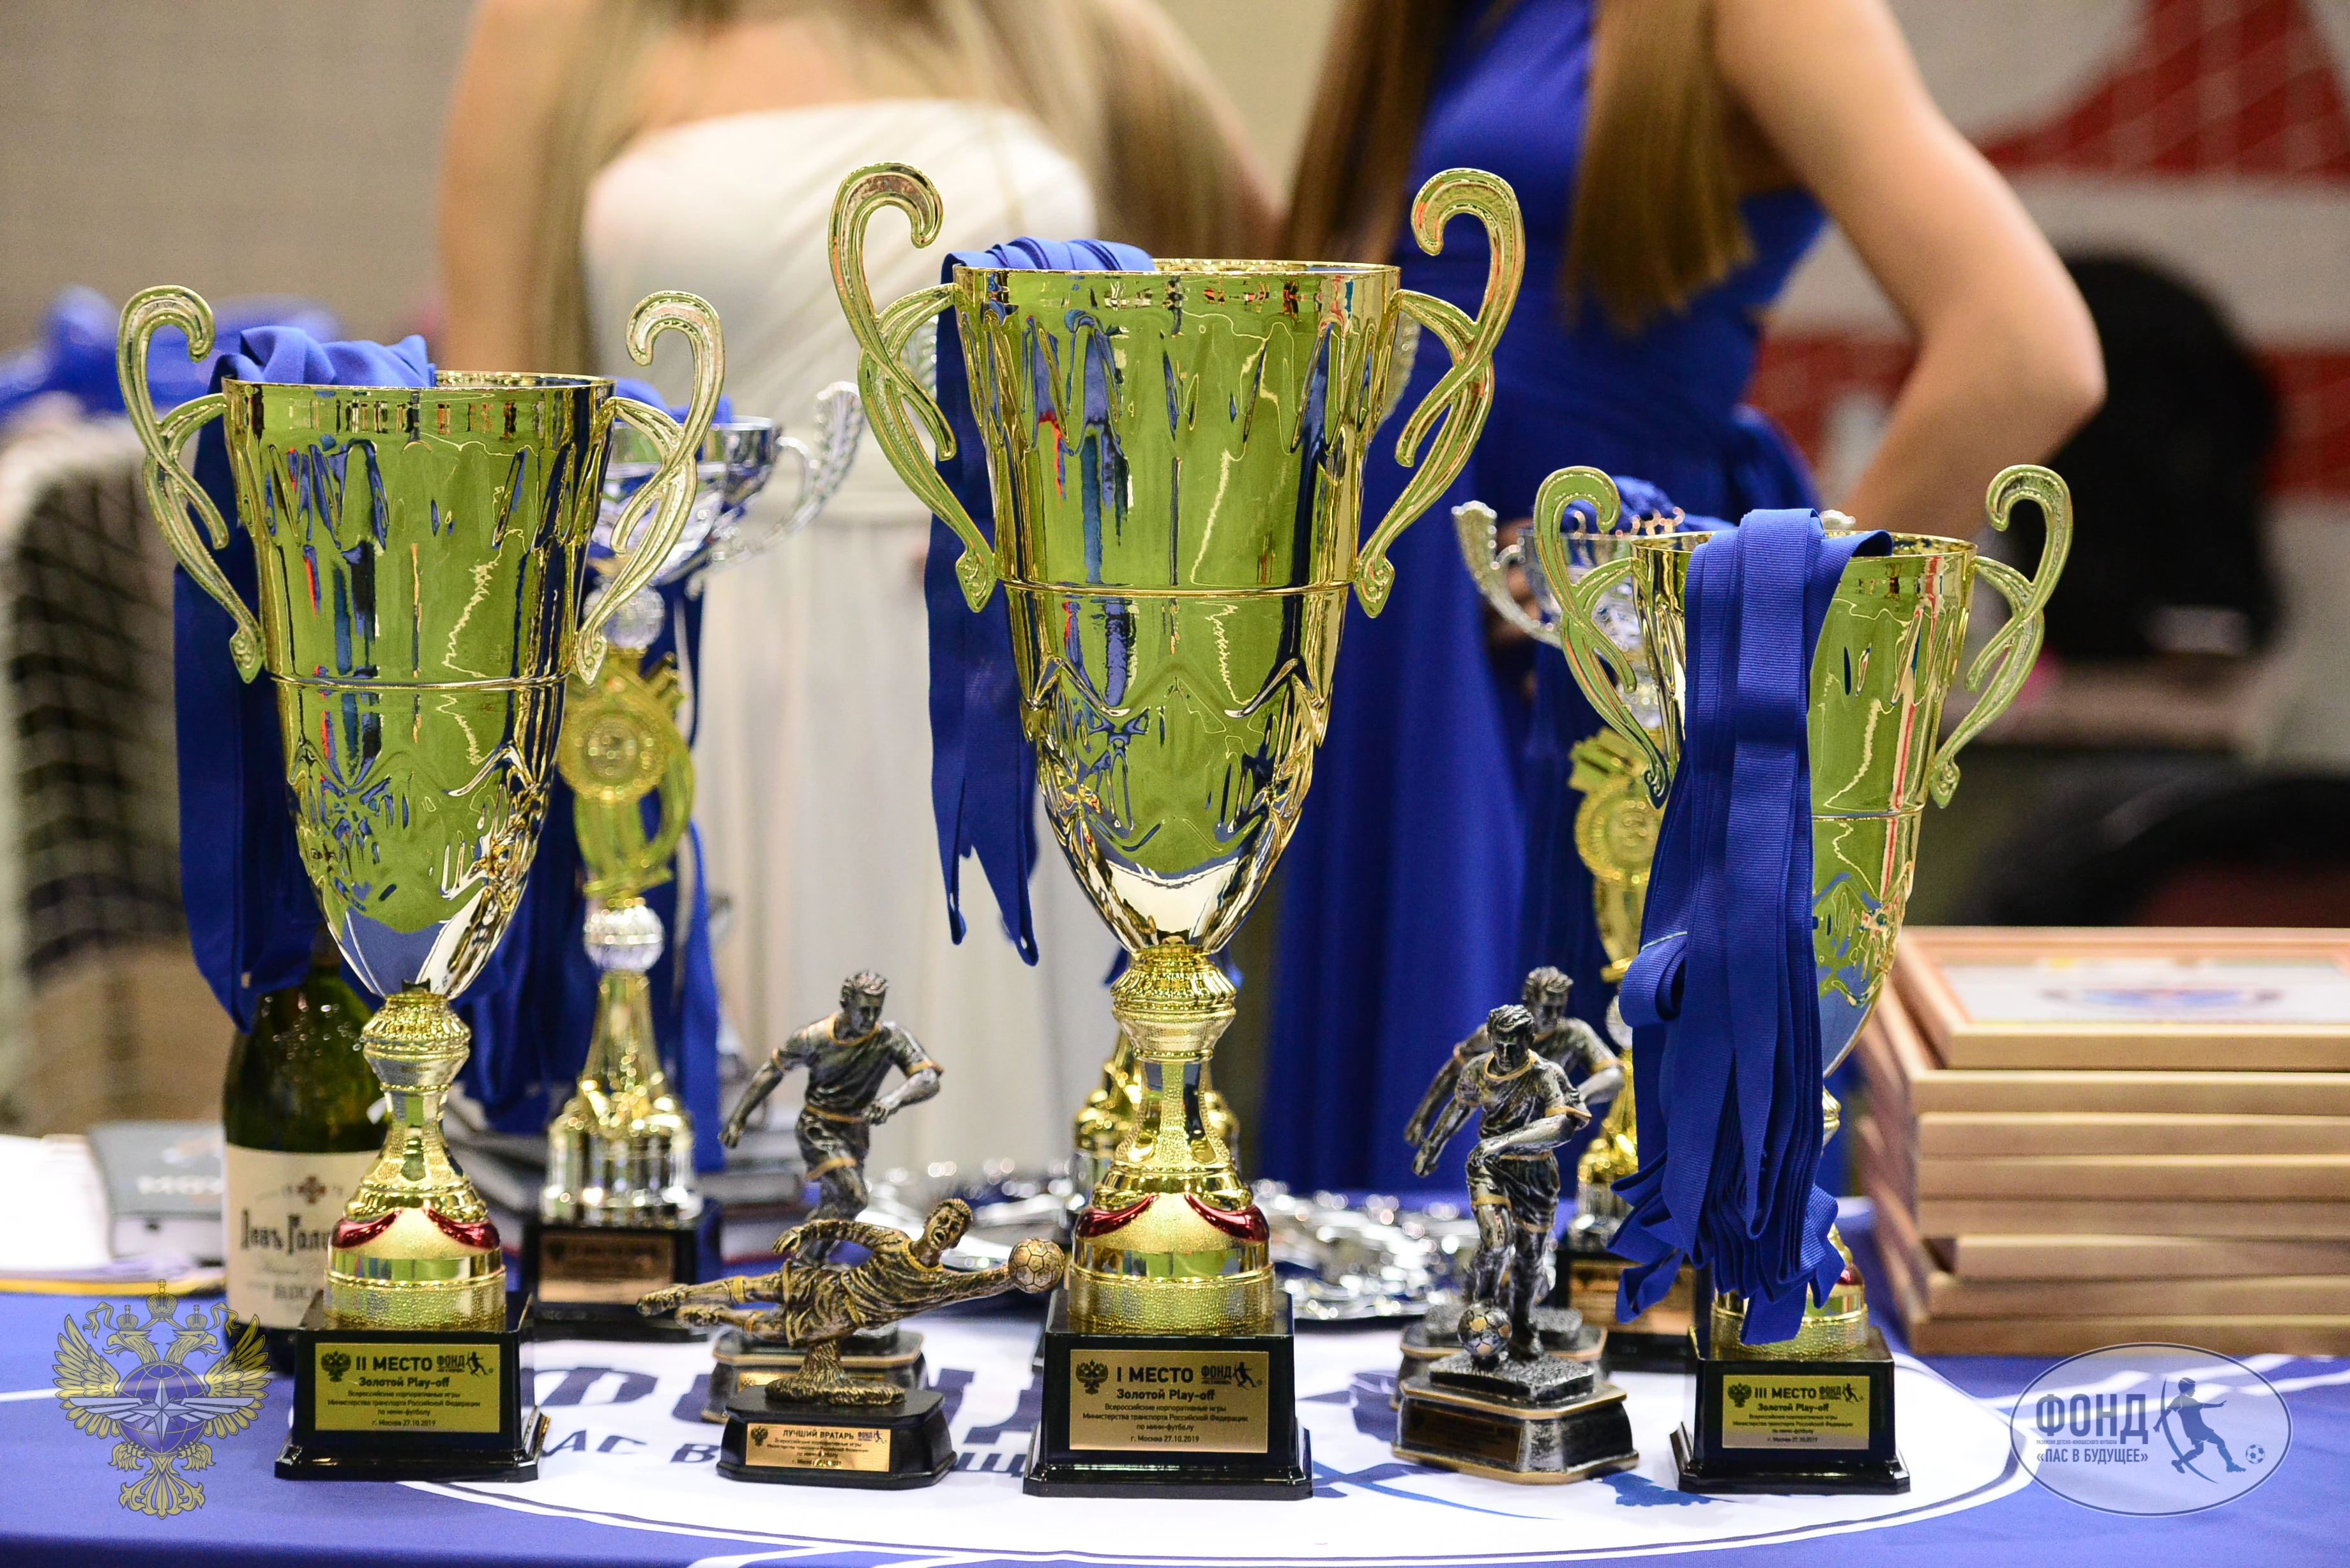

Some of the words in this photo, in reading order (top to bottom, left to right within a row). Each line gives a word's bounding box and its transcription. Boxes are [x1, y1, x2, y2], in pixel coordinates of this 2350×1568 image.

[372, 1356, 433, 1372] МЕСТО
[436, 1355, 466, 1368] ФОНД
[1128, 1366, 1194, 1383] МЕСТО
[1201, 1365, 1232, 1379] ФОНД
[358, 1376, 404, 1387] Золотой
[407, 1376, 450, 1389] Play-off
[1116, 1389, 1165, 1400] Золотой
[1169, 1389, 1215, 1402] Play-off
[1771, 1387, 1816, 1399] МЕСТО
[1757, 1403, 1793, 1412] Золотой
[1146, 1423, 1194, 1432] мини-футболу
[783, 1429, 817, 1438] ЛУЧШИЙ
[820, 1431, 854, 1440] ВРАТАРЬ
